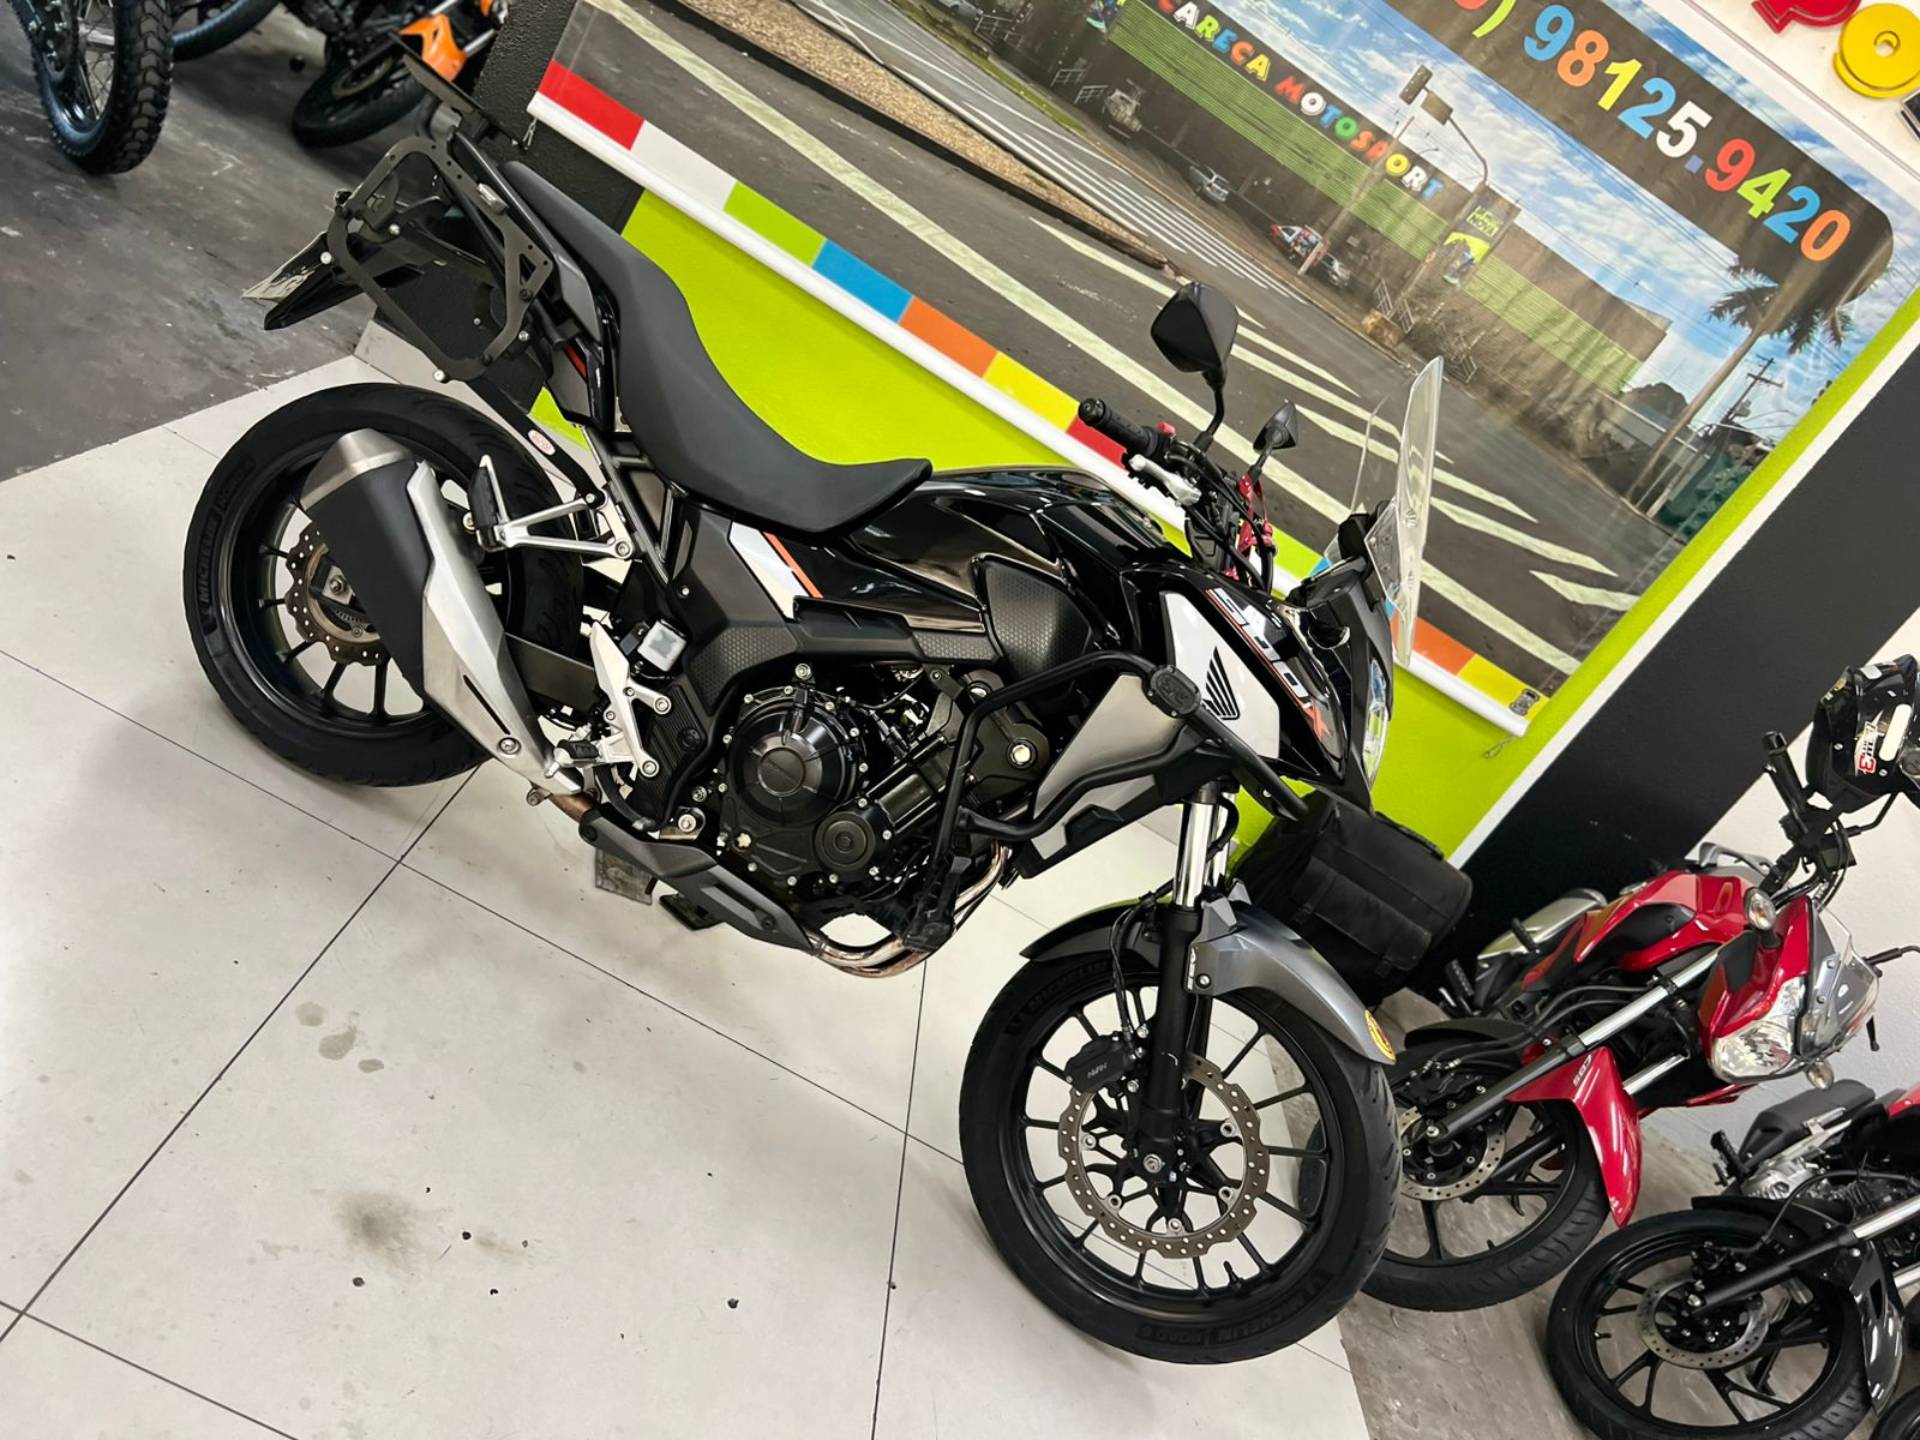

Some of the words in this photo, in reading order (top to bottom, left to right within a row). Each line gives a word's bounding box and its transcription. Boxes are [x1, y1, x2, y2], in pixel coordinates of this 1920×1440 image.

[1158, 0, 1272, 82] CARECA
[1275, 75, 1445, 202] MOTOSPORT
[1523, 4, 1851, 262] 98125.9420
